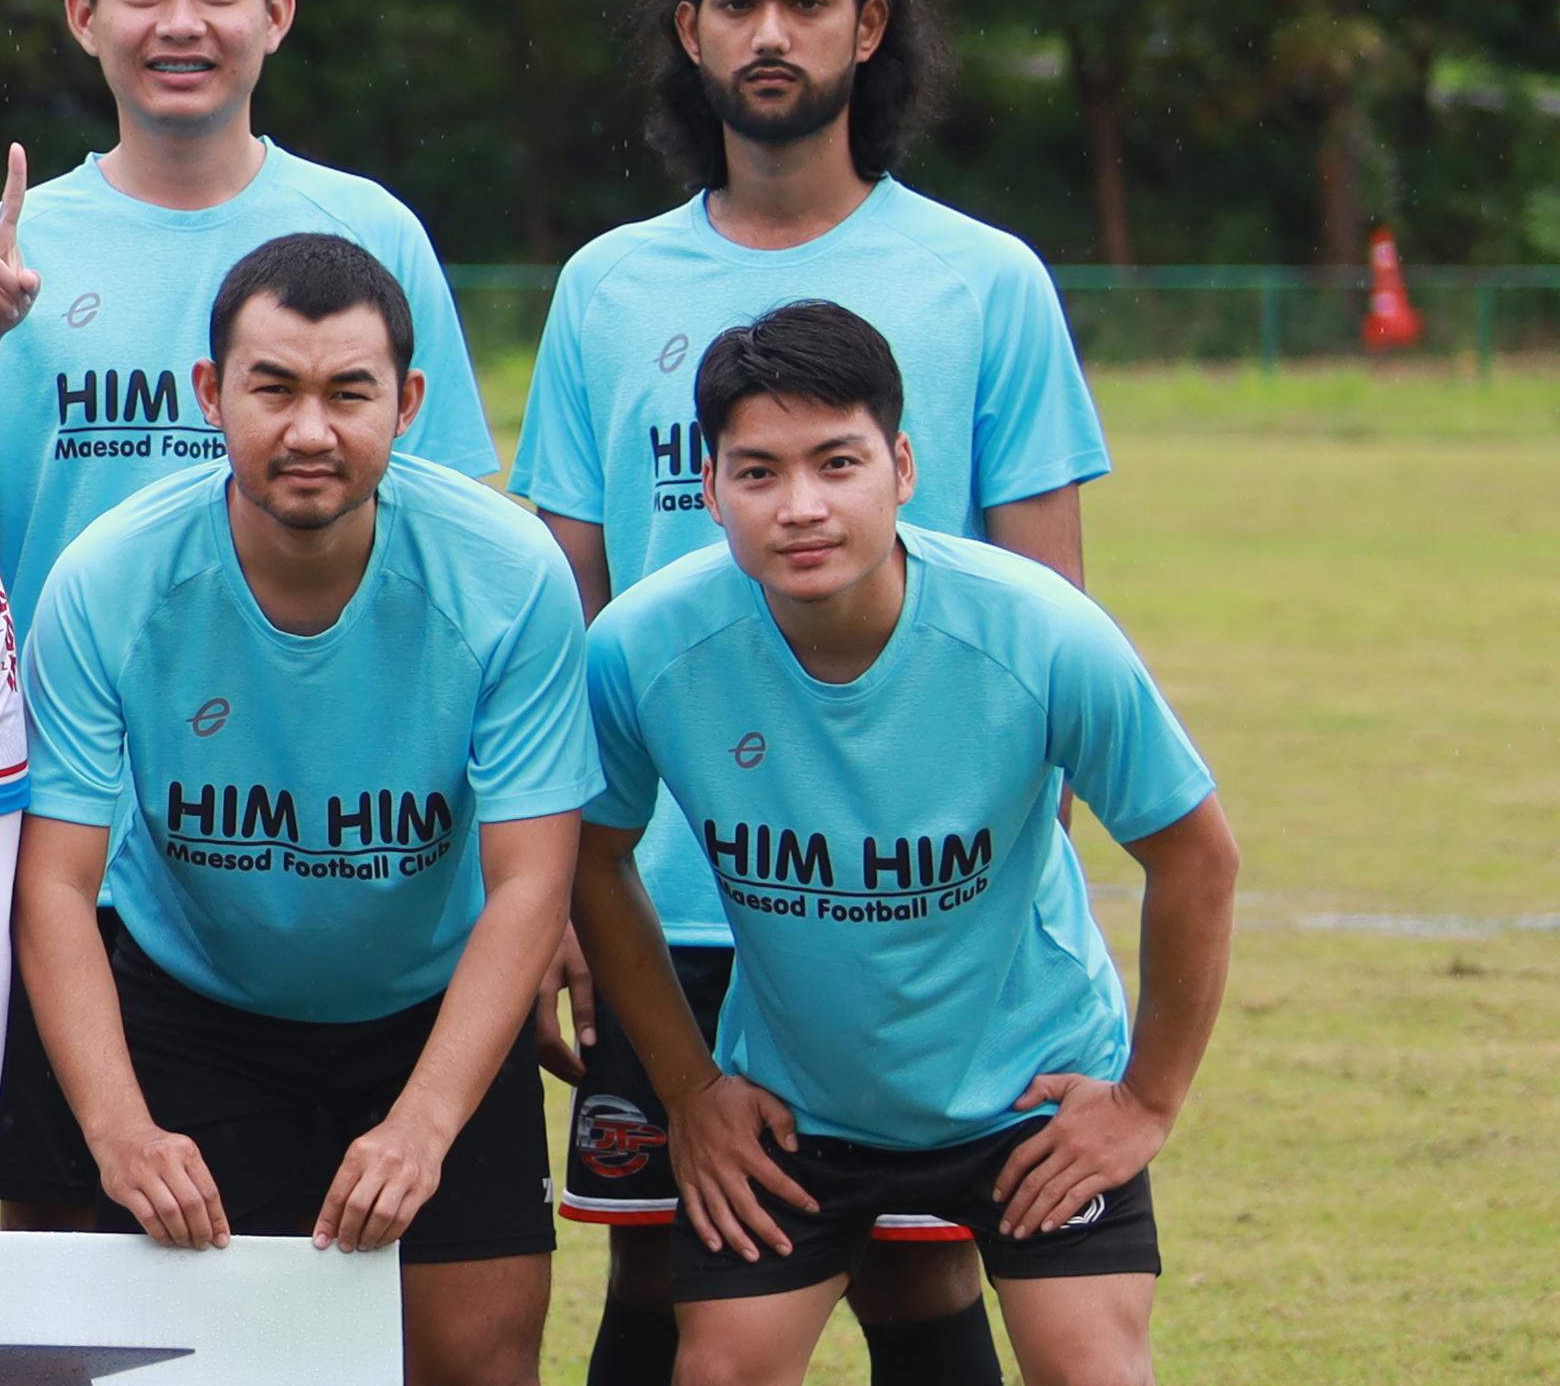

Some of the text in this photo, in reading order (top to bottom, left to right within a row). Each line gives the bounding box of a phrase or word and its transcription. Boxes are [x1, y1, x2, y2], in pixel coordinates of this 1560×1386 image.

[57, 369, 179, 425] HIM
[55, 434, 226, 461] Maesod Footb
[650, 421, 702, 479] HI
[168, 781, 452, 847] HIM HIM
[166, 839, 451, 880] Maesod Football Club
[704, 819, 992, 890] HIM HIM
[818, 897, 927, 922] Football
[938, 877, 987, 912] Club
